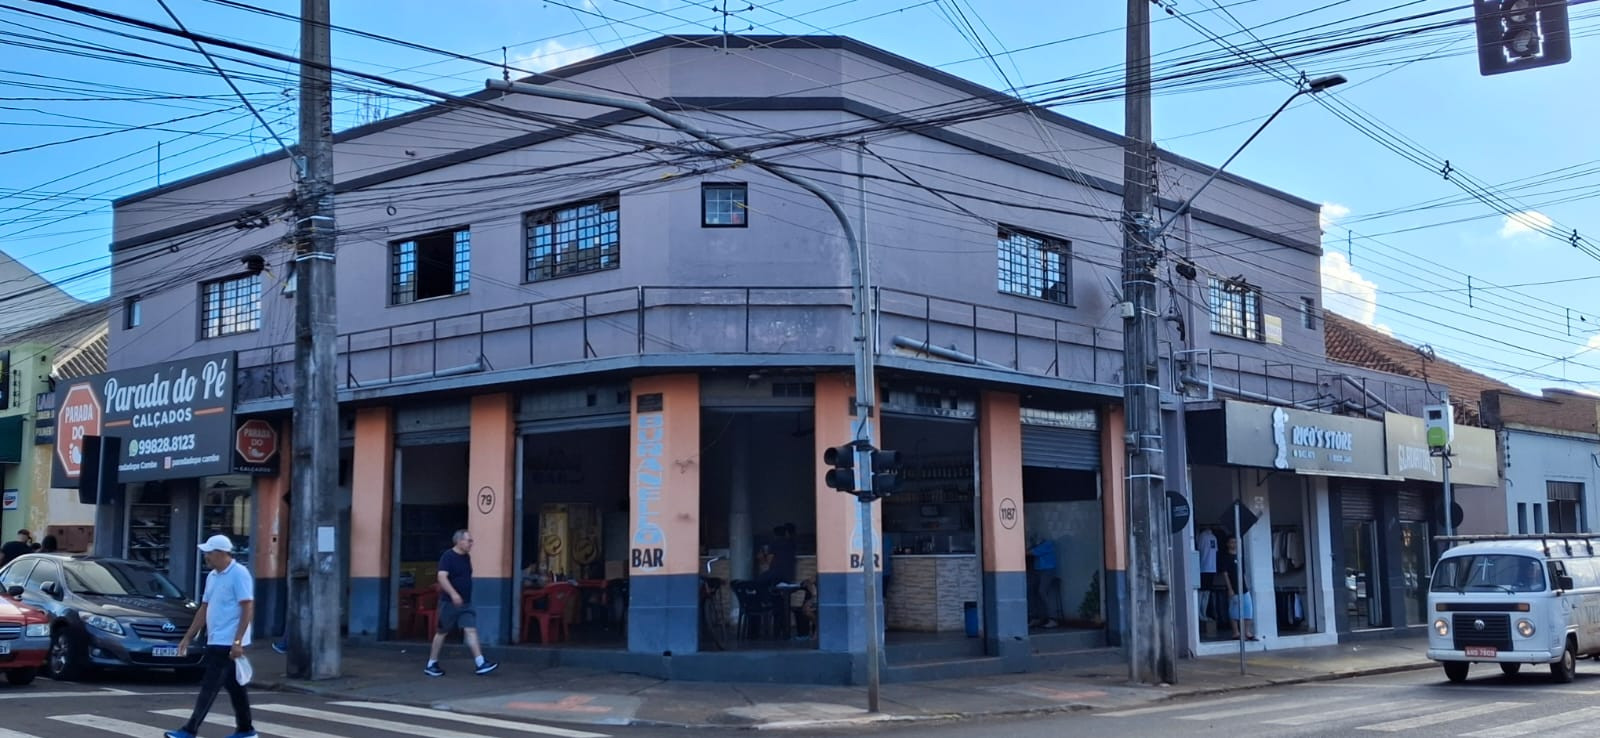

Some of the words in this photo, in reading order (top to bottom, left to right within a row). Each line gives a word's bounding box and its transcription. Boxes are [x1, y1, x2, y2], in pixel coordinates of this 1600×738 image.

[104, 373, 170, 414] Parada
[173, 368, 198, 403] do
[202, 358, 228, 400] Pé
[64, 404, 94, 424] PARADA
[132, 407, 193, 429] CALÇADOS
[71, 427, 85, 441] DO
[243, 428, 271, 438] PARADA
[1292, 425, 1323, 448] RICO'S
[1325, 430, 1353, 451] STORE
[138, 433, 196, 455] 99828.8123
[480, 494, 493, 506] 79
[1001, 507, 1015, 521] 1187
[631, 548, 664, 568] BAR
[849, 553, 880, 569] BR
